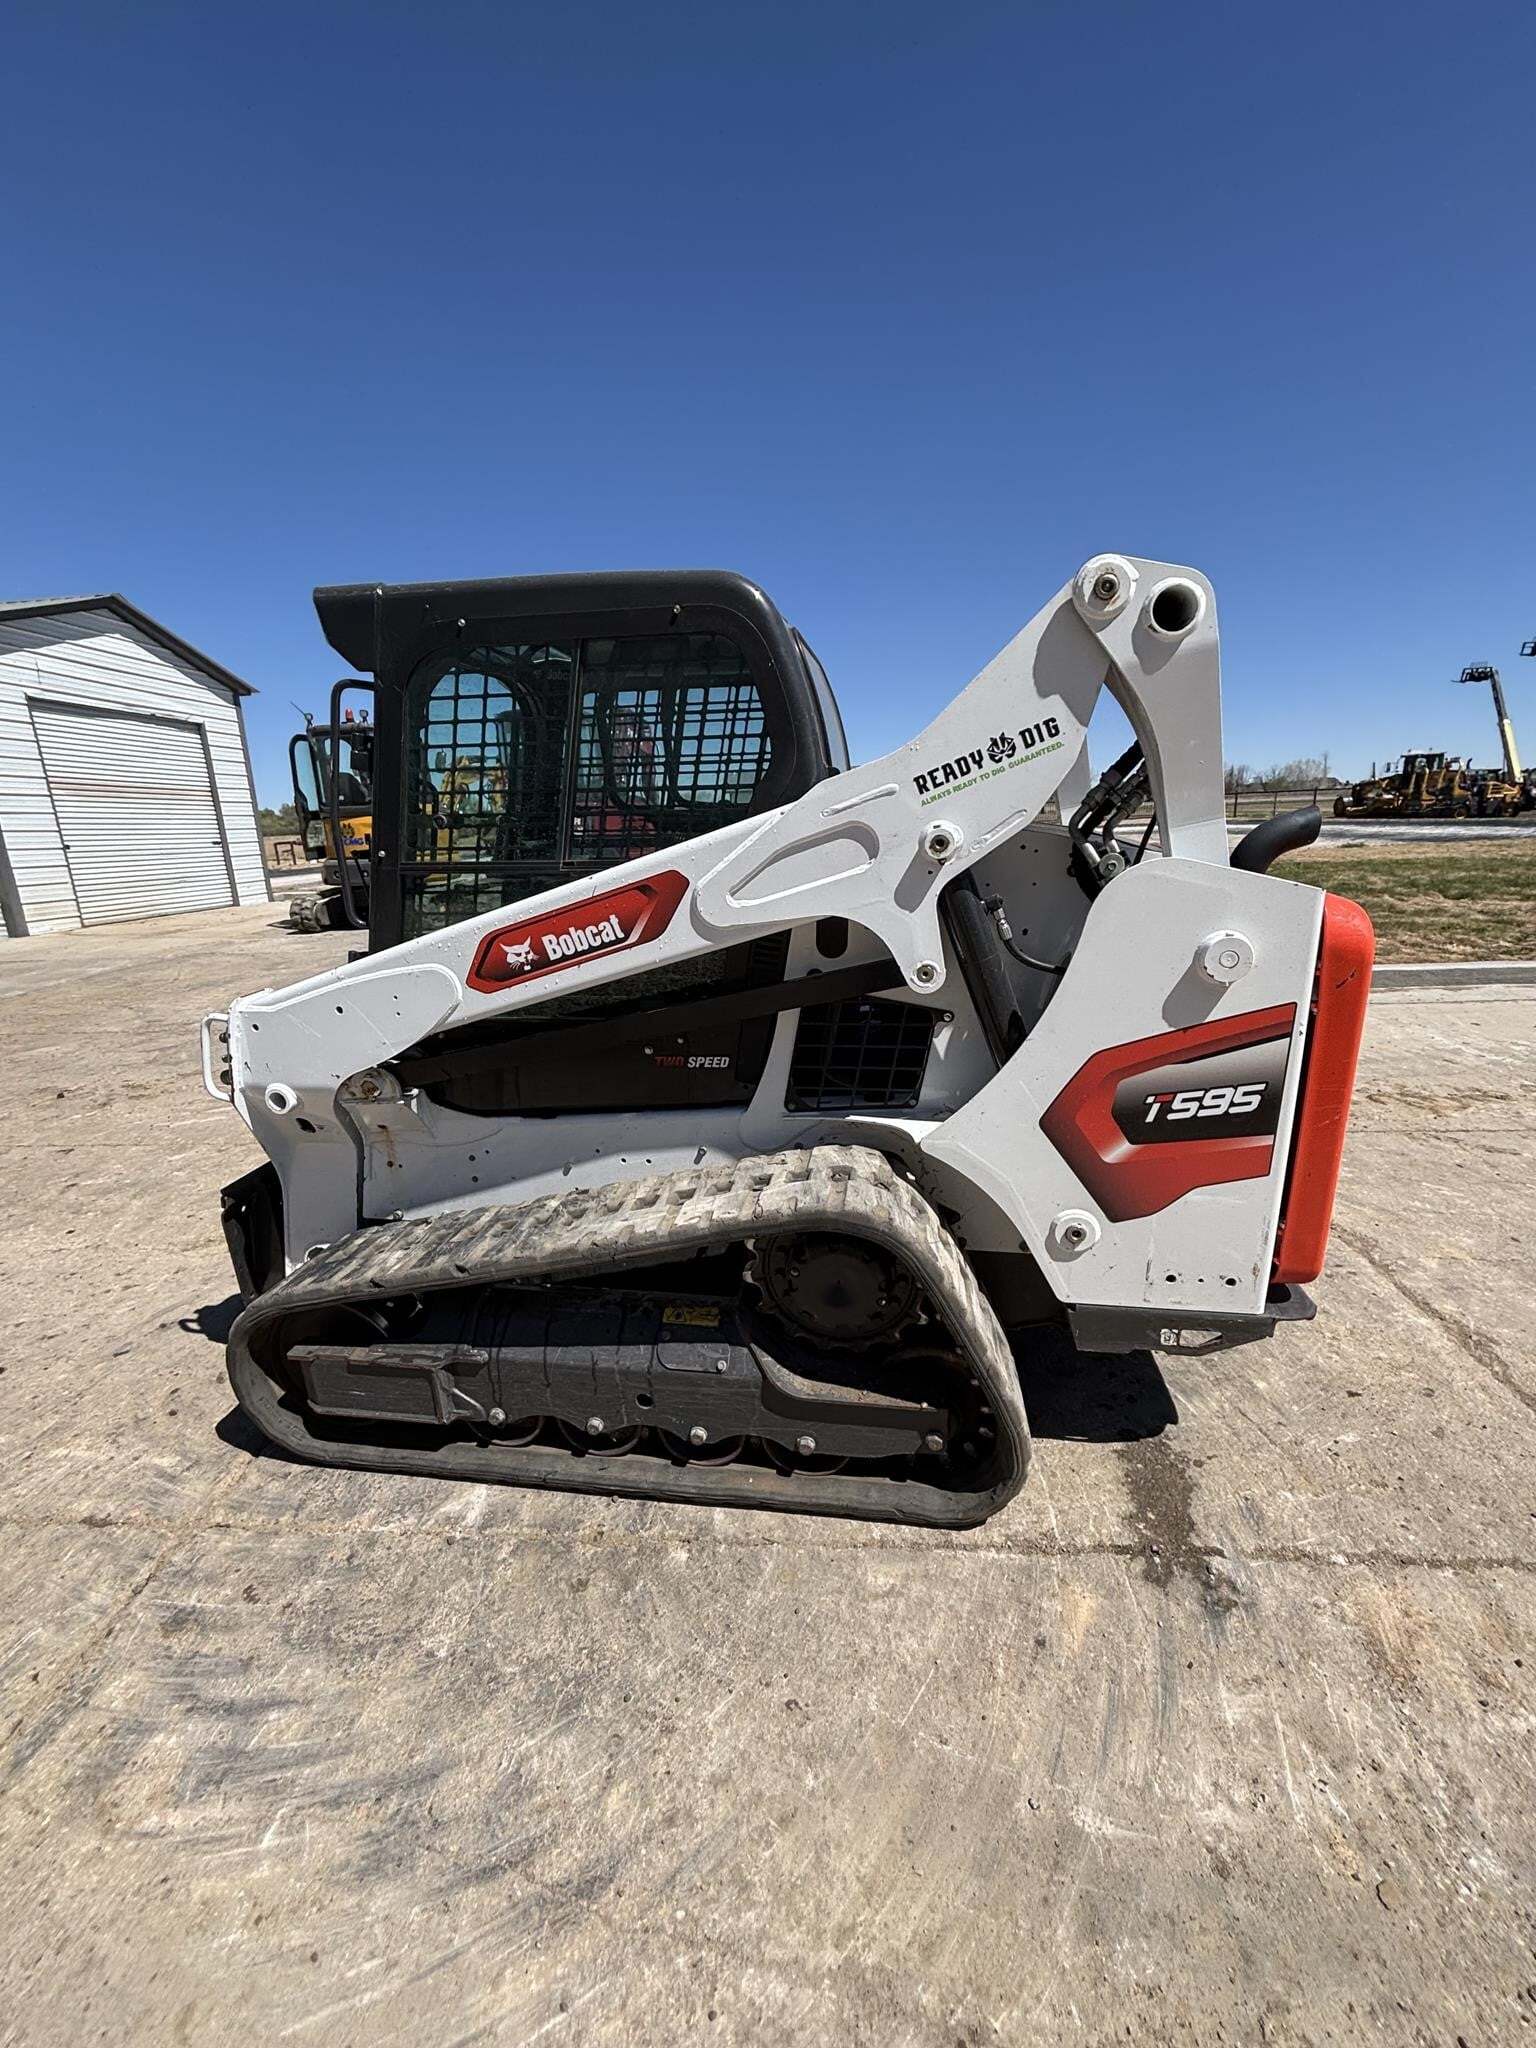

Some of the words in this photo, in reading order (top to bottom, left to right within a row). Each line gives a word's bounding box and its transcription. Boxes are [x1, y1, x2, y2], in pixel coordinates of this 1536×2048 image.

[913, 748, 984, 795] READY
[1018, 716, 1060, 749] DIG
[921, 789, 952, 807] ALWAYS
[952, 777, 978, 793] READY
[979, 772, 990, 782] TO
[991, 765, 1006, 777] DIG
[1008, 741, 1065, 769] GUARANTEED.
[541, 914, 625, 961] Bobcat
[655, 1056, 685, 1068] TWO
[687, 1056, 730, 1068] SPEED
[1145, 1083, 1266, 1124] T595
